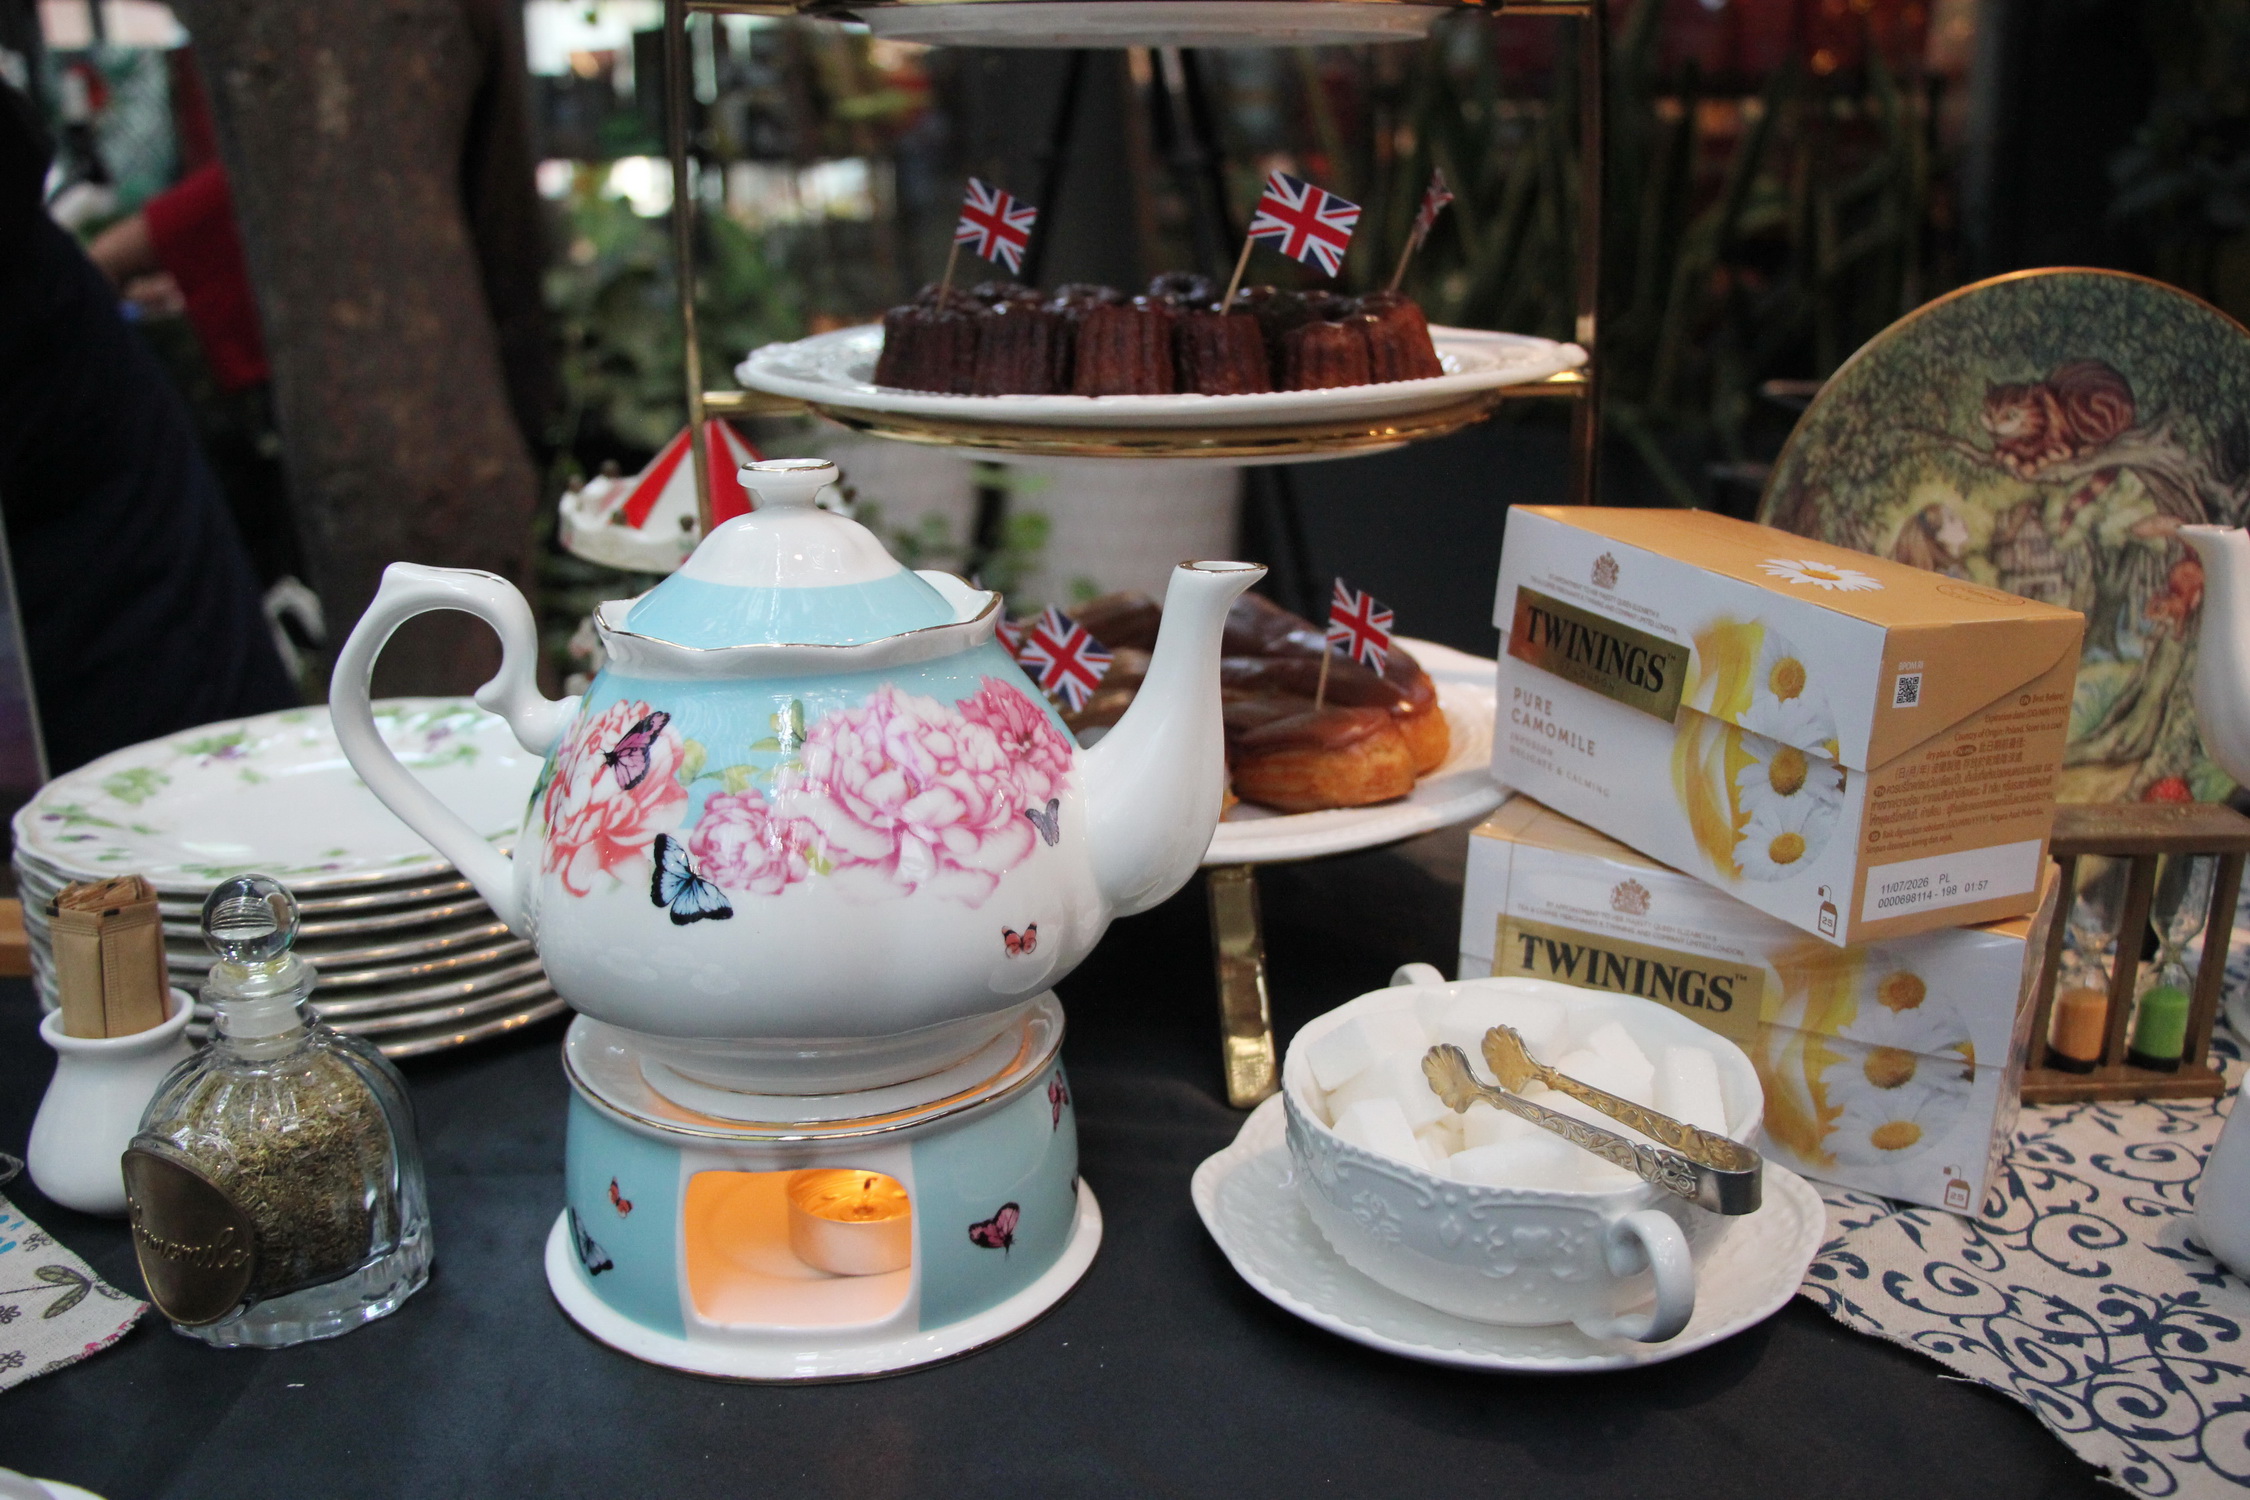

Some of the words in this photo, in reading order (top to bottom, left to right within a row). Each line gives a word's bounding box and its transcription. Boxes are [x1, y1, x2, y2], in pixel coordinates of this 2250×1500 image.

[1528, 605, 1667, 693] TWININGS
[1513, 686, 1552, 716] PURE
[1511, 708, 1596, 756] CAMOMILE
[1566, 771, 1610, 797] CALMING
[1878, 891, 1932, 908] 0000698114
[1941, 885, 1957, 897] 198
[1964, 880, 1988, 893] 01:57
[1881, 877, 1929, 894] 11/07/2026
[1939, 873, 1950, 884] PL
[1822, 915, 1834, 927] 25
[1518, 932, 1733, 1013] TWININGS
[1950, 1190, 1965, 1202] 25
